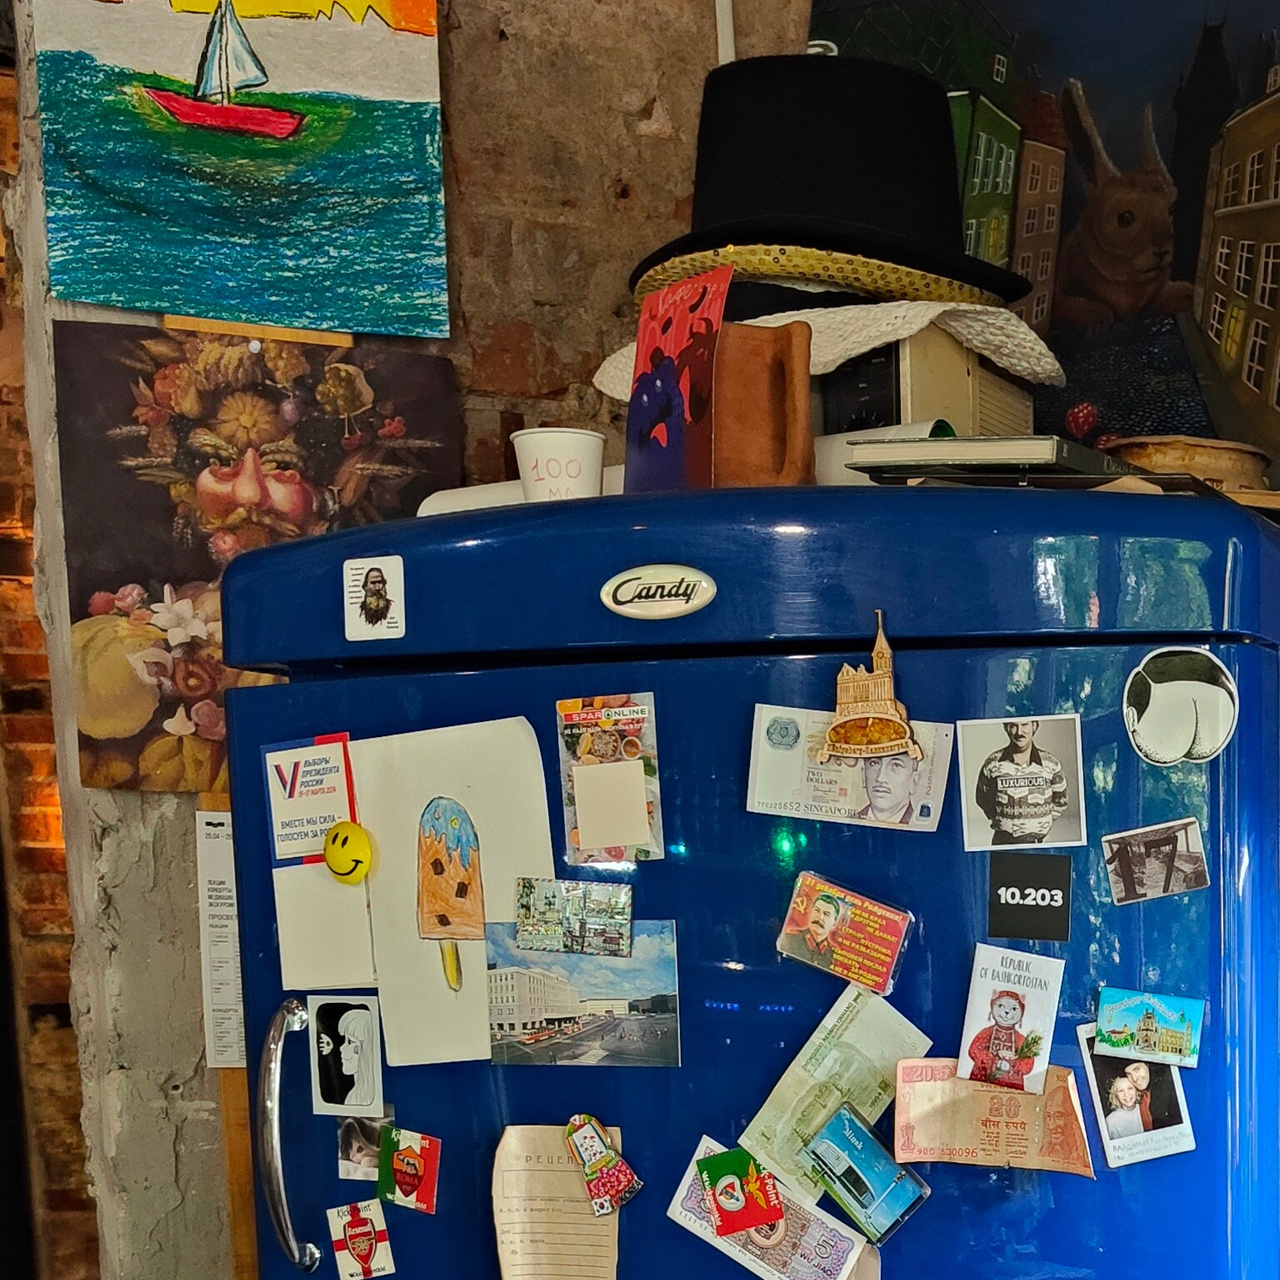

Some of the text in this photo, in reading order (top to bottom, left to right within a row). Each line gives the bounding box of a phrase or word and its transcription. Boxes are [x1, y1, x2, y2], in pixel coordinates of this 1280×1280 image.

[530, 457, 583, 484] 100
[611, 576, 700, 607] Candy
[571, 712, 602, 721] SPAR
[301, 765, 340, 778] ПРЕЗИДЕНТА
[304, 757, 331, 768] ВЫБОРЫ
[300, 778, 324, 789] РОССИИ
[806, 776, 838, 786] DOLLARS
[998, 776, 1045, 789] LUXURIOUS
[281, 814, 337, 829] ВМЕСТЕ МЫ СИЛА
[277, 831, 310, 843] ГОЛОСУЕМ
[310, 830, 319, 839] ЗА
[804, 876, 816, 888] 21
[997, 887, 1064, 907] 10.203
[1000, 955, 1033, 974] REPUBLIC
[979, 966, 1050, 992] OF BASHKORTOSTAN
[800, 1040, 826, 1071] ZHONGGUO
[834, 999, 855, 1025] YINHANG
[988, 1095, 1022, 1119] 20
[839, 1125, 867, 1151] Minsk
[395, 1174, 419, 1186] ROMA
[619, 1180, 644, 1204] KOREA
[809, 1232, 840, 1263] 5
[797, 1251, 835, 1279] WU JIAO
